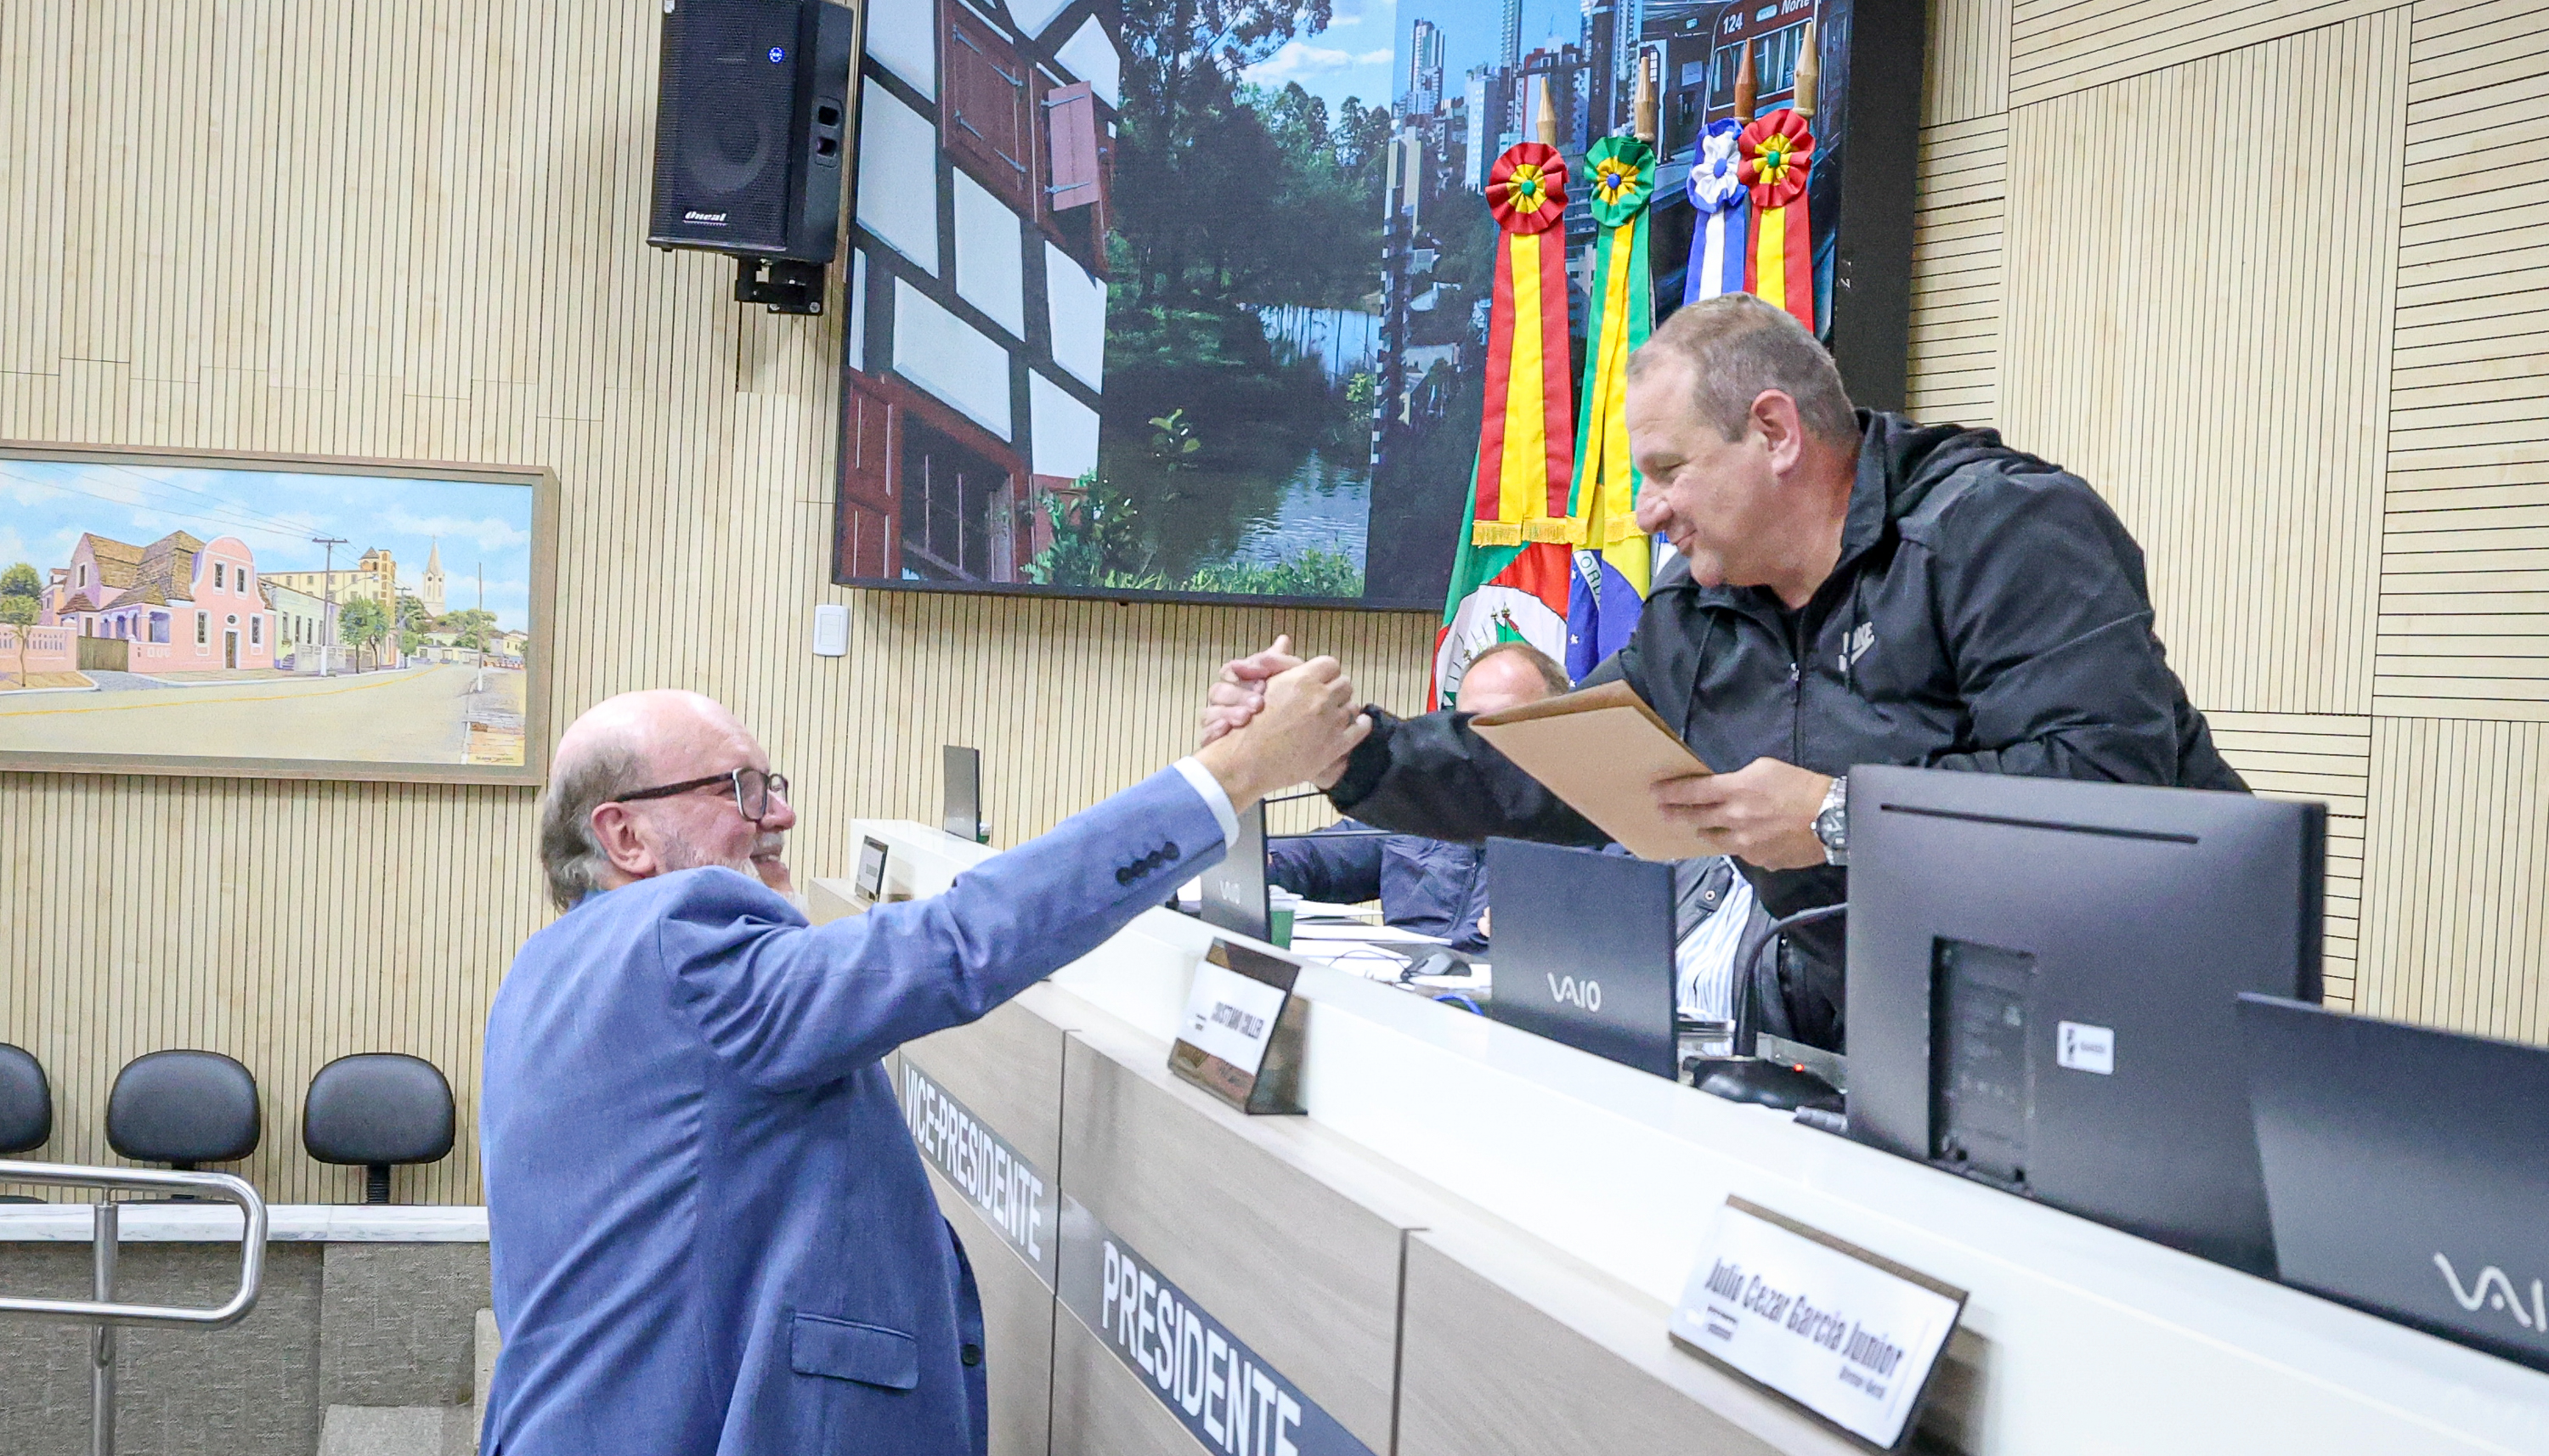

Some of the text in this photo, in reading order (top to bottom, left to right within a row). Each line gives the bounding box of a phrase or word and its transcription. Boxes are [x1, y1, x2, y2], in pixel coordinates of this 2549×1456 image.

[1723, 12, 1743, 35] 124
[1580, 556, 1601, 601] ORD
[1547, 972, 1601, 1012] VAIO
[905, 1064, 1043, 1262] VICE-PRESIDENTE
[1102, 1240, 1302, 1456] PRESIDENTE
